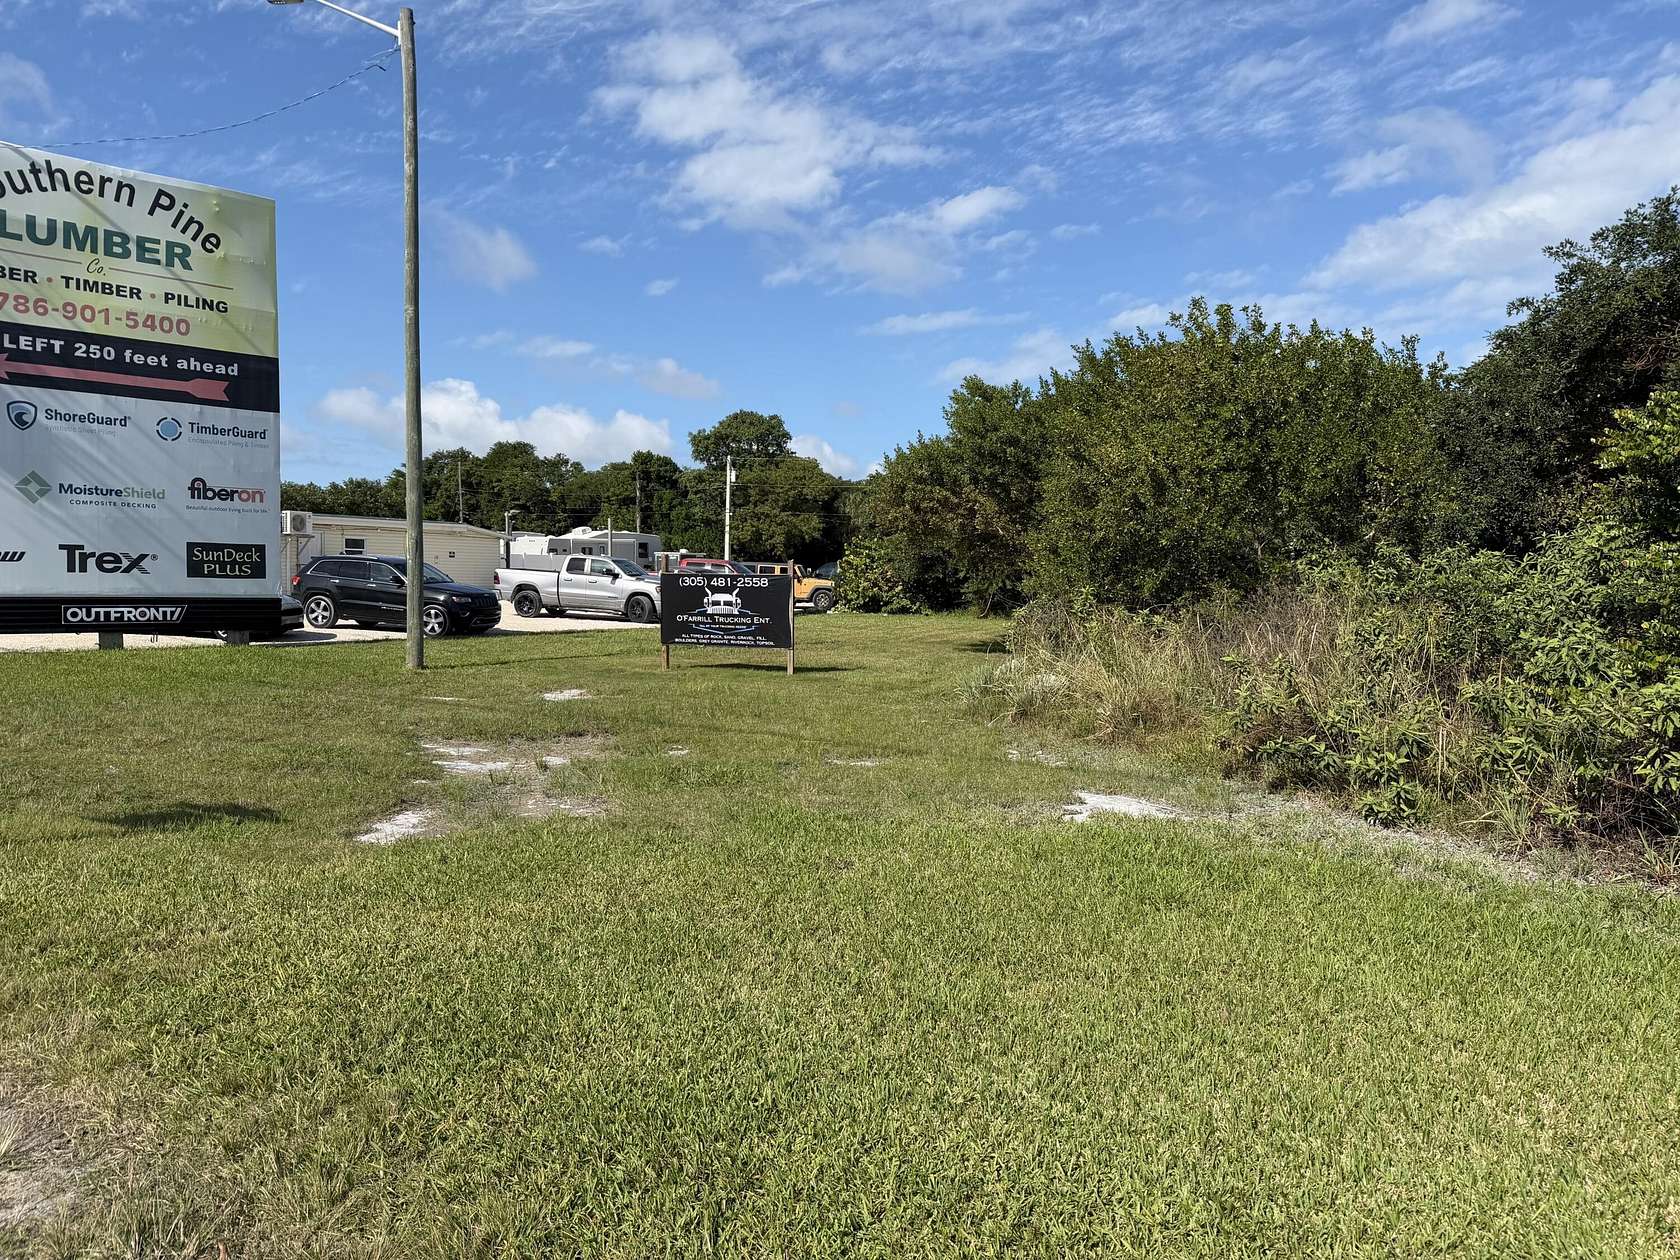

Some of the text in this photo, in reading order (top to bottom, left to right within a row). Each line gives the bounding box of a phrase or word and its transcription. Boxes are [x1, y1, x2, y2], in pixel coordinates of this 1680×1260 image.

[0, 159, 222, 254] uthern Pine
[0, 208, 194, 271] LUMBER
[86, 257, 107, 276] Co.
[60, 275, 142, 301] TIMBER
[163, 291, 229, 314] PILING
[3, 333, 239, 376] LEFT 250 feet ahead
[58, 482, 166, 500] MoistureShield
[188, 477, 266, 504] fiberon
[69, 499, 157, 509] COMPOSITE DECKING
[192, 547, 261, 563] SunDeck
[203, 563, 252, 576] PLUS
[679, 577, 769, 587] (305) 481-2558
[676, 614, 773, 624] O'FARRILL TRUCKING ENT.
